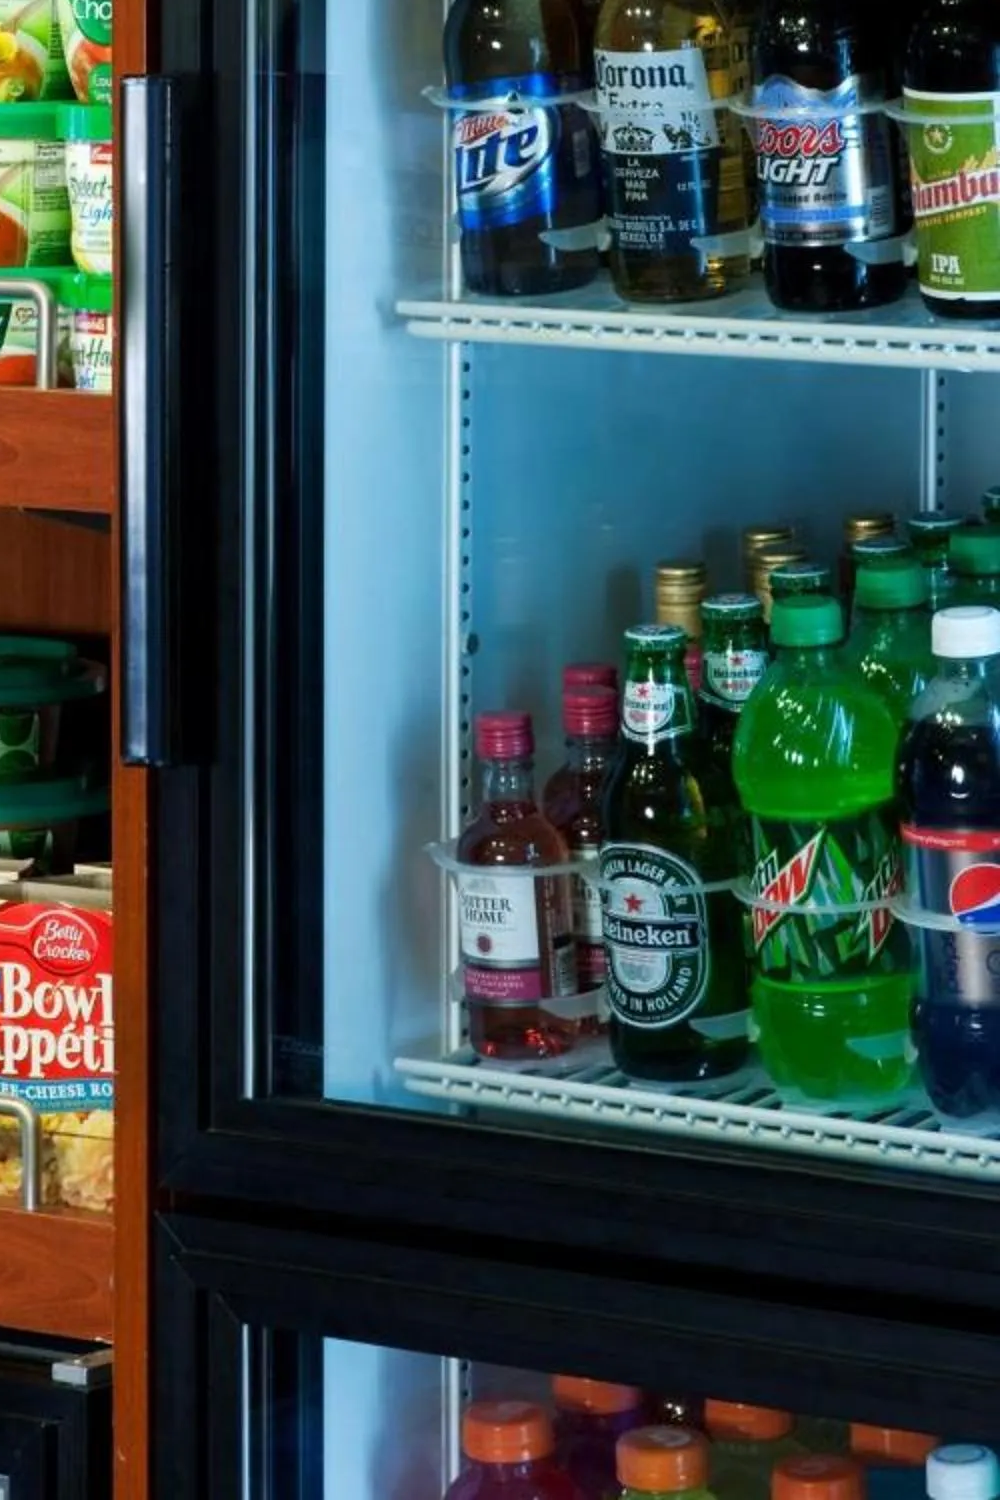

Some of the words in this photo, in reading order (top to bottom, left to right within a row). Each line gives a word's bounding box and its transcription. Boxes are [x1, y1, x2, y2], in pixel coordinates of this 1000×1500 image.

[596, 53, 687, 91] Corona
[614, 167, 660, 179] CERVEZA
[626, 157, 640, 167] LA
[930, 253, 961, 275] IPA
[626, 859, 666, 882] LAGER
[464, 907, 506, 925] HOME
[45, 919, 84, 947] Betty
[33, 936, 92, 962] Crocker
[629, 997, 643, 1012] IN
[647, 966, 693, 1013] HOLLAND
